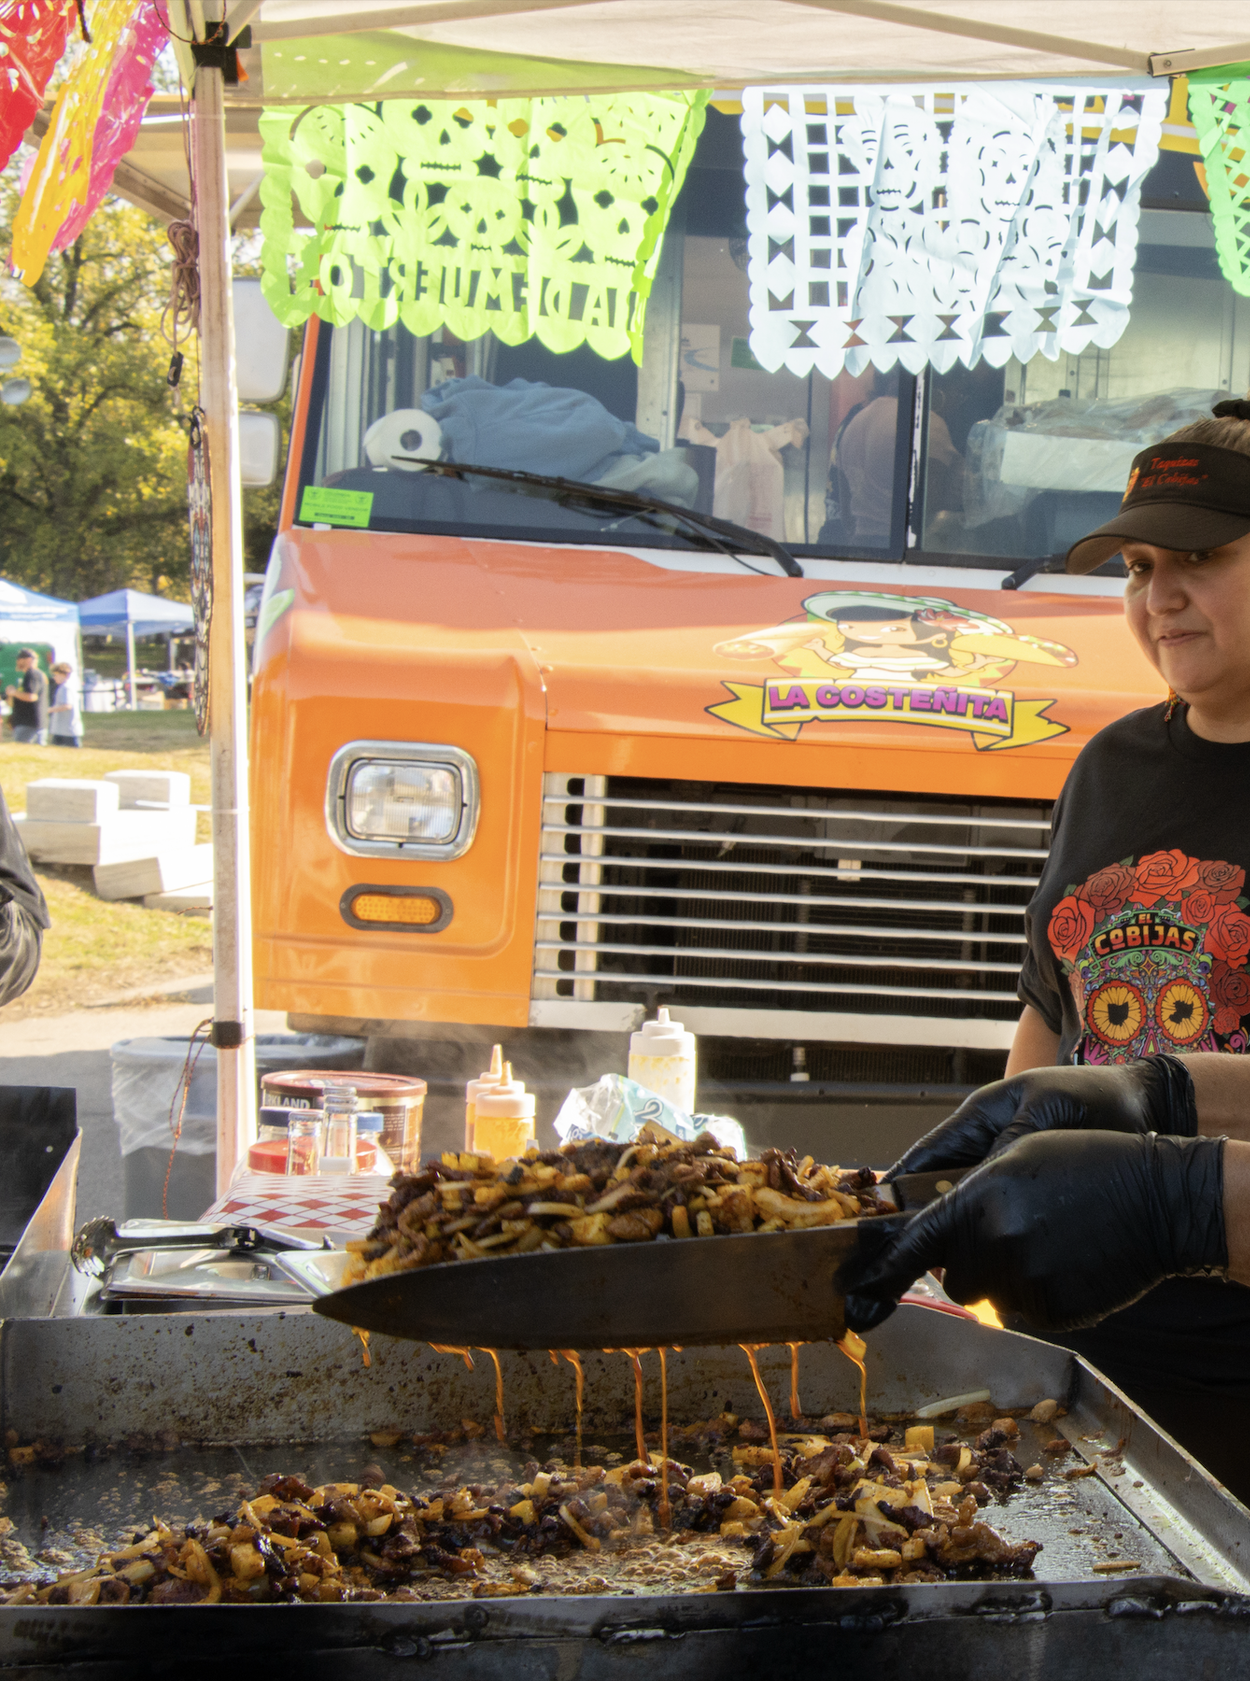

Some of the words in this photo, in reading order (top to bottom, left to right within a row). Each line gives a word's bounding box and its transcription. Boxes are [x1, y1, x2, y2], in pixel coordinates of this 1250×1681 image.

[769, 686, 810, 711] LA
[816, 685, 1009, 722] COSTEÑITA
[1138, 913, 1153, 924] EL
[1095, 926, 1196, 954] COBIJAS
